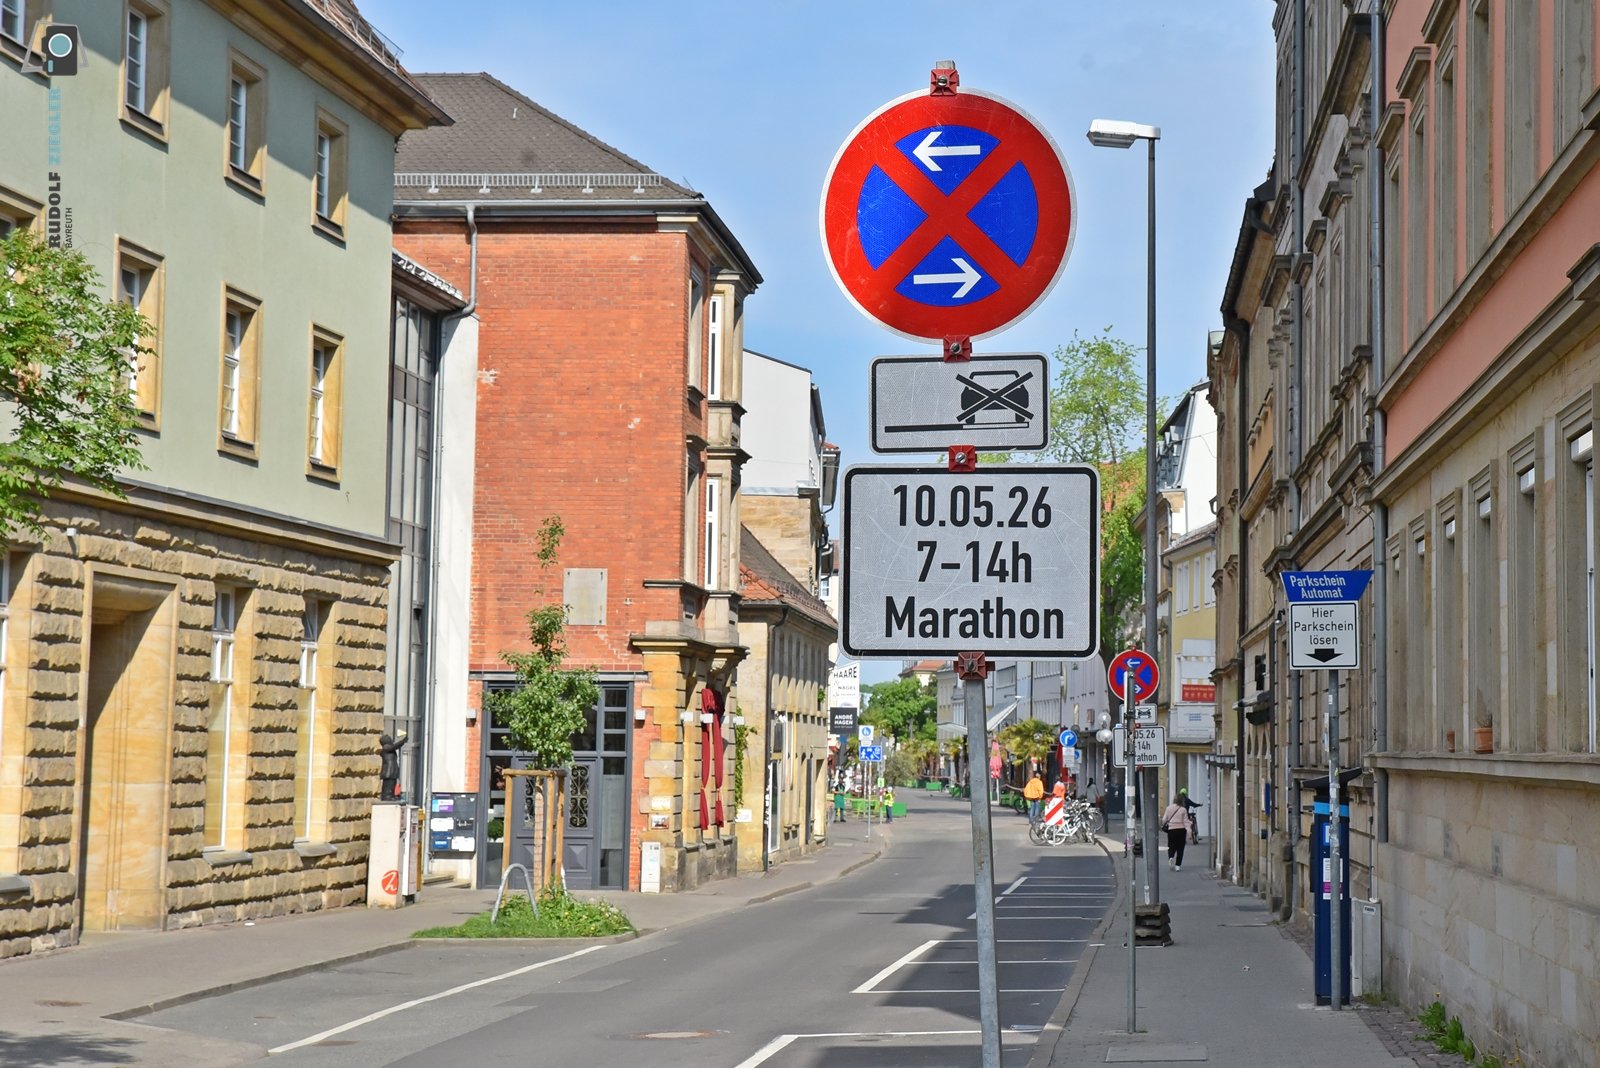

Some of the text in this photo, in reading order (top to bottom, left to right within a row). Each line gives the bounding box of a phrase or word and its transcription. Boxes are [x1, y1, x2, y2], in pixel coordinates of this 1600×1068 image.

[893, 484, 1052, 528] 10.05.26
[1289, 574, 1346, 587] Parkschein
[1301, 587, 1343, 598] Automat
[885, 595, 1064, 640] Marathon
[1312, 608, 1334, 618] Hier
[1294, 620, 1354, 632] Parkschein
[1309, 634, 1338, 645] lösen
[834, 667, 857, 678] HAARE
[1135, 729, 1156, 739] 05.26
